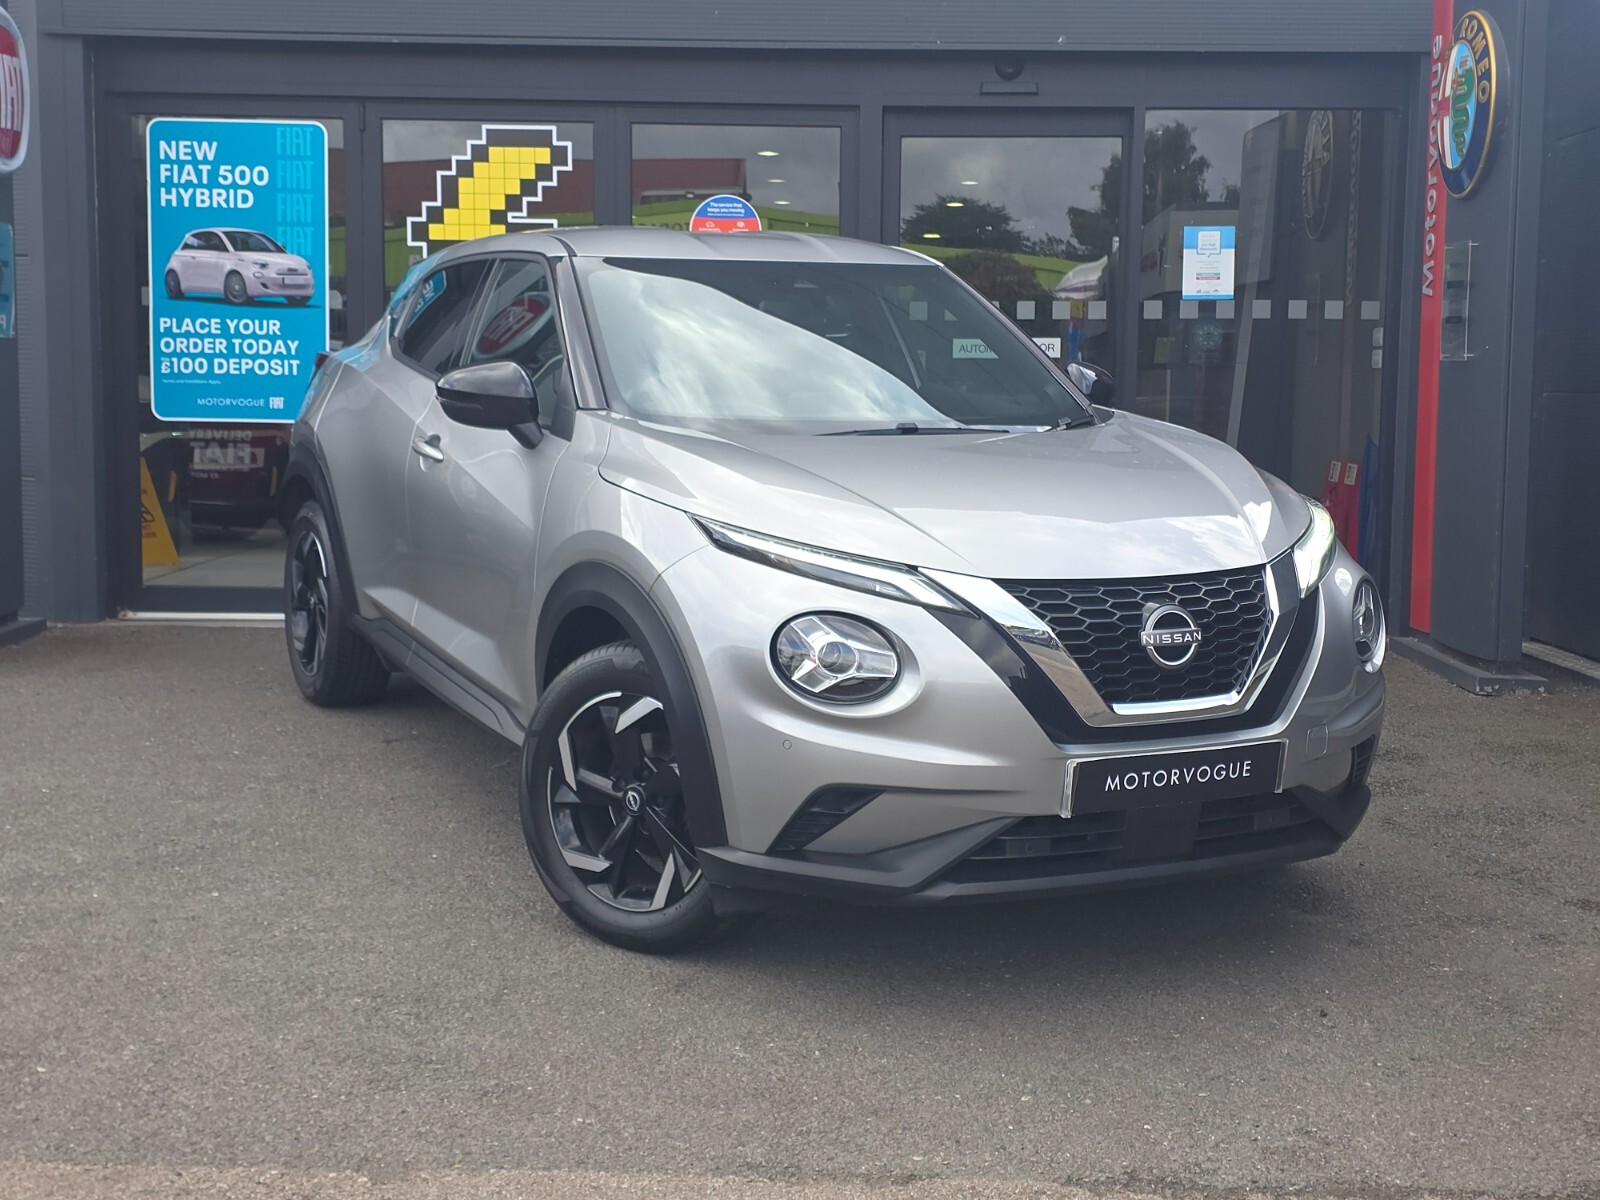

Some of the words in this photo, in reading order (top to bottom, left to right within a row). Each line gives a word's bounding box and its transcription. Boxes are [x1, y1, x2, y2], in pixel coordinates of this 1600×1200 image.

[1459, 18, 1490, 104] ROMEO
[159, 140, 217, 161] NEW
[277, 127, 314, 156] FIAT
[160, 164, 211, 184] FIAT
[218, 165, 269, 186] 500
[277, 160, 314, 189] FIAT
[160, 188, 254, 209] HYBRID
[277, 193, 314, 222] FIAT
[159, 317, 221, 335] PLACE
[225, 318, 281, 336] YOUR
[160, 338, 227, 354] ORDER
[232, 339, 299, 356] TODAY
[160, 357, 208, 374] £100
[214, 358, 300, 376] DEPOSIT
[197, 397, 265, 407] MOTORVOGUE
[269, 396, 284, 409] FIAT
[1142, 631, 1202, 644] NISSAN
[1105, 760, 1252, 792] MOTORVOGUE
